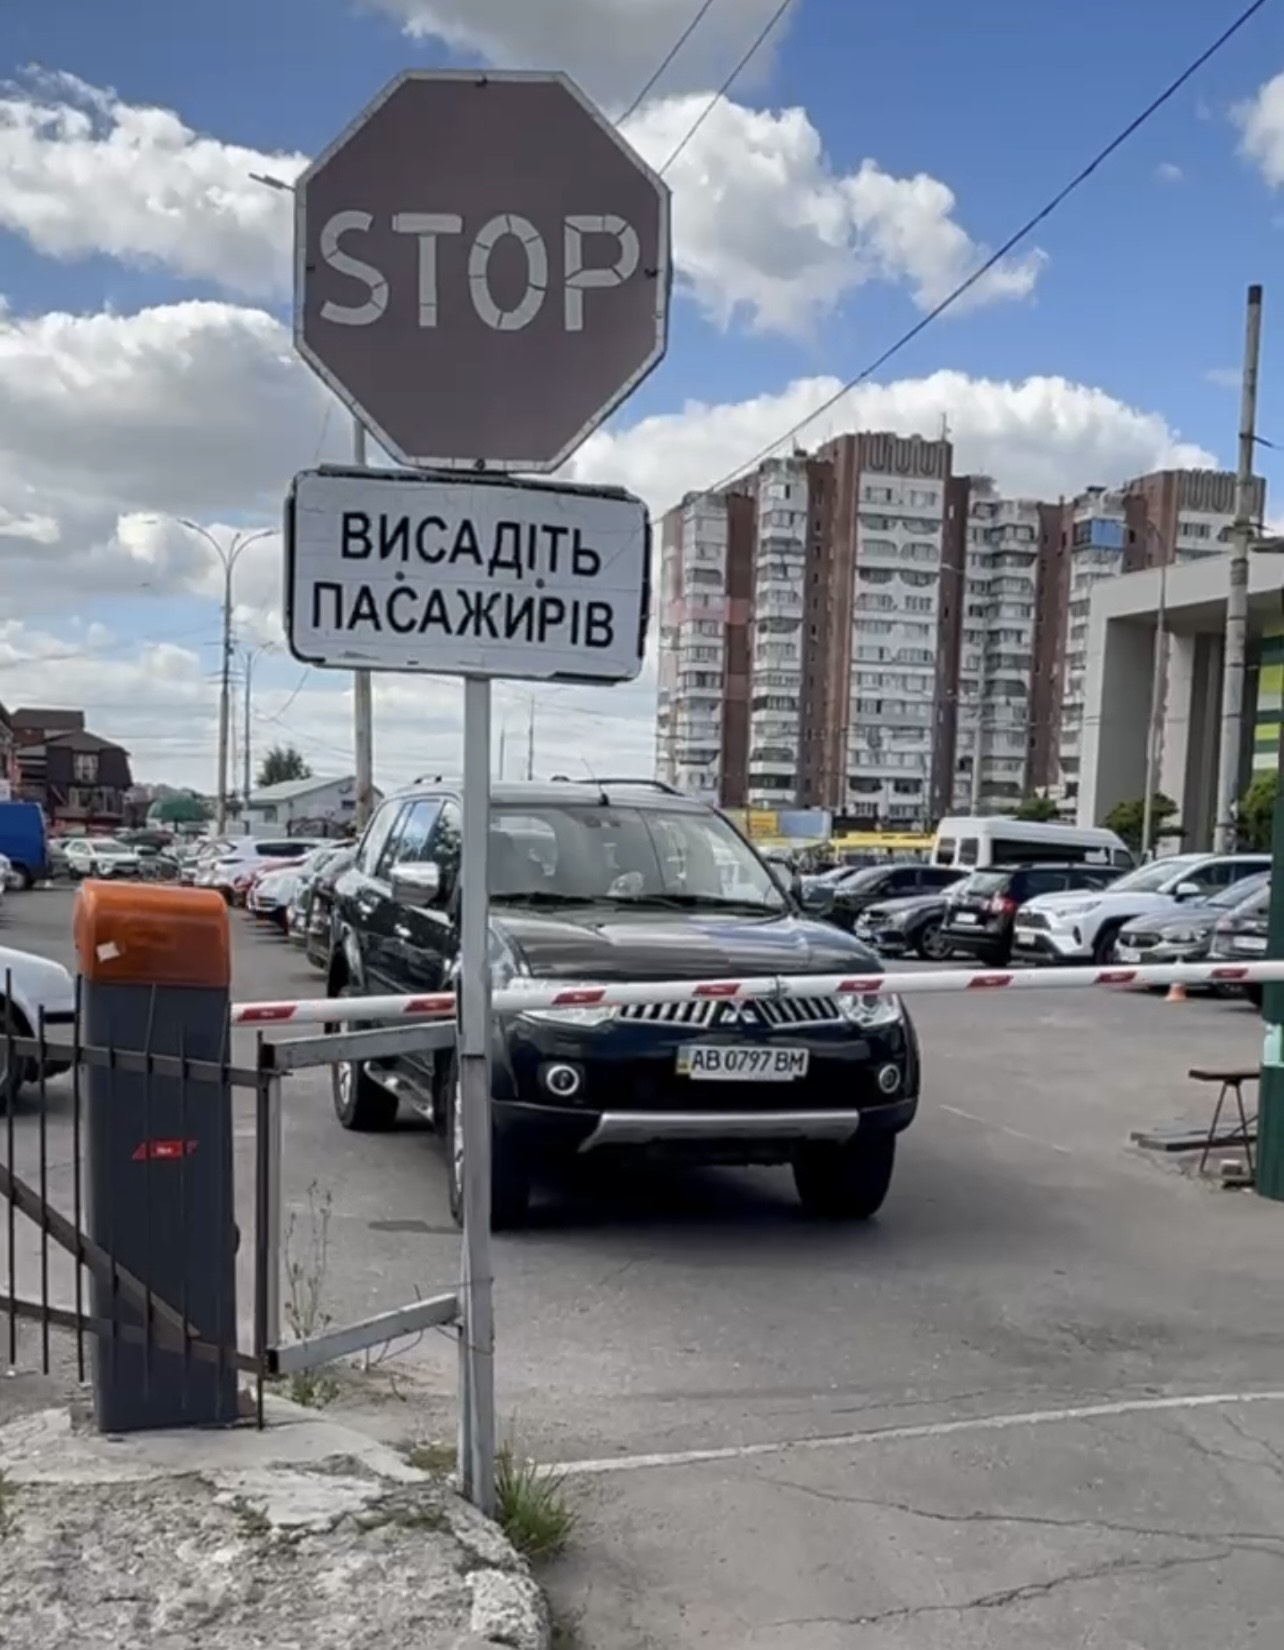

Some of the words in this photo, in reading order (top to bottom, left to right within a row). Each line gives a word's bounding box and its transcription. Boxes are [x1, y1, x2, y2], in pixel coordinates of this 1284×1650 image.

[320, 210, 640, 331] STOP
[341, 511, 602, 576] ВИСАДІТЬ
[311, 582, 615, 647] ПАСАЖИРІВ
[692, 1050, 720, 1071] AB
[725, 1051, 771, 1072] 0797
[774, 1053, 804, 1073] BM
